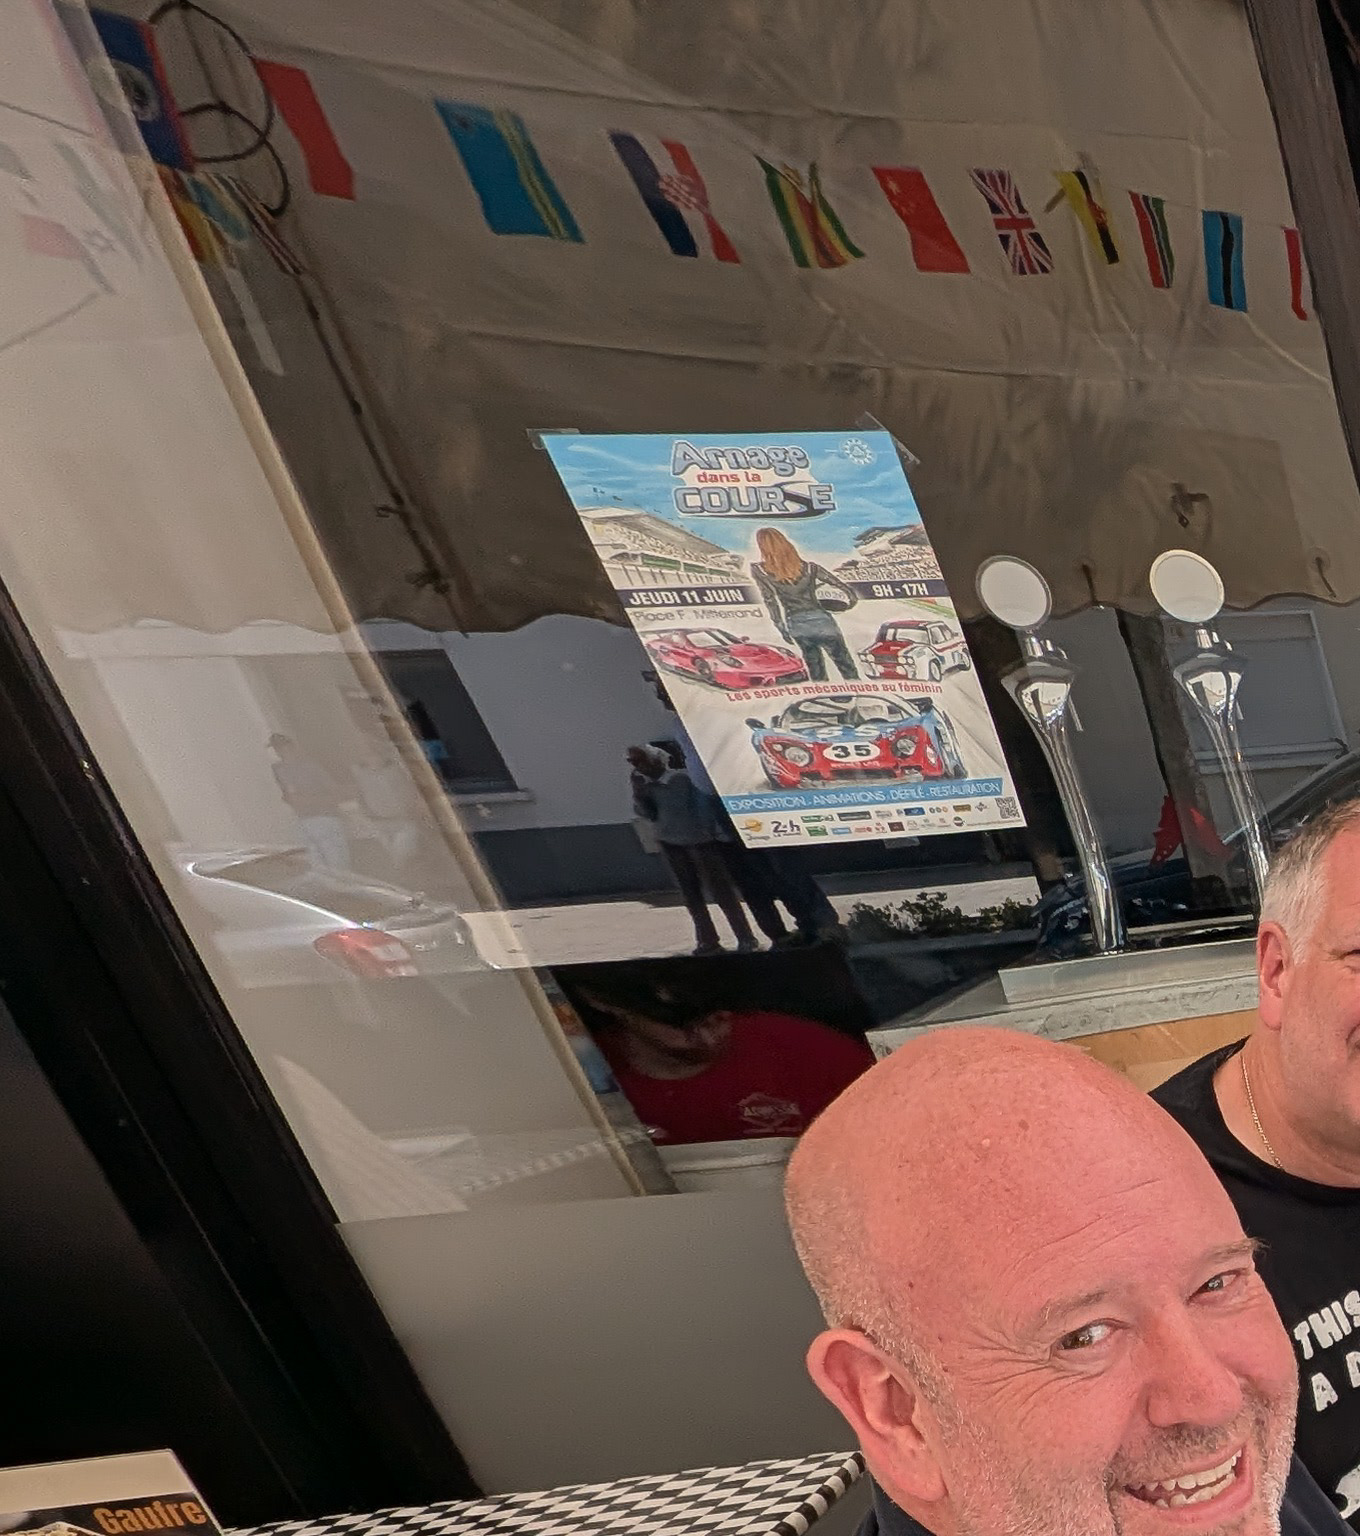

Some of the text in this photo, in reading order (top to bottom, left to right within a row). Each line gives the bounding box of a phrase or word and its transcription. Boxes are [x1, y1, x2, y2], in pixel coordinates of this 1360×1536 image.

[673, 440, 810, 475] Arnage
[697, 471, 762, 483] dans la
[674, 484, 836, 514] COURSE
[629, 588, 744, 605] JEUDI 11 JUIN
[873, 582, 929, 597] 9H 17H
[726, 680, 943, 702] Les sports mécaniques au féminin
[832, 744, 871, 759] 35
[729, 794, 806, 811] EXPOSITION
[813, 790, 886, 806] ANIMATIONS
[929, 781, 1001, 797] RESTAURATION
[1311, 1372, 1338, 1412] A
[92, 1500, 207, 1535] Gaufre
